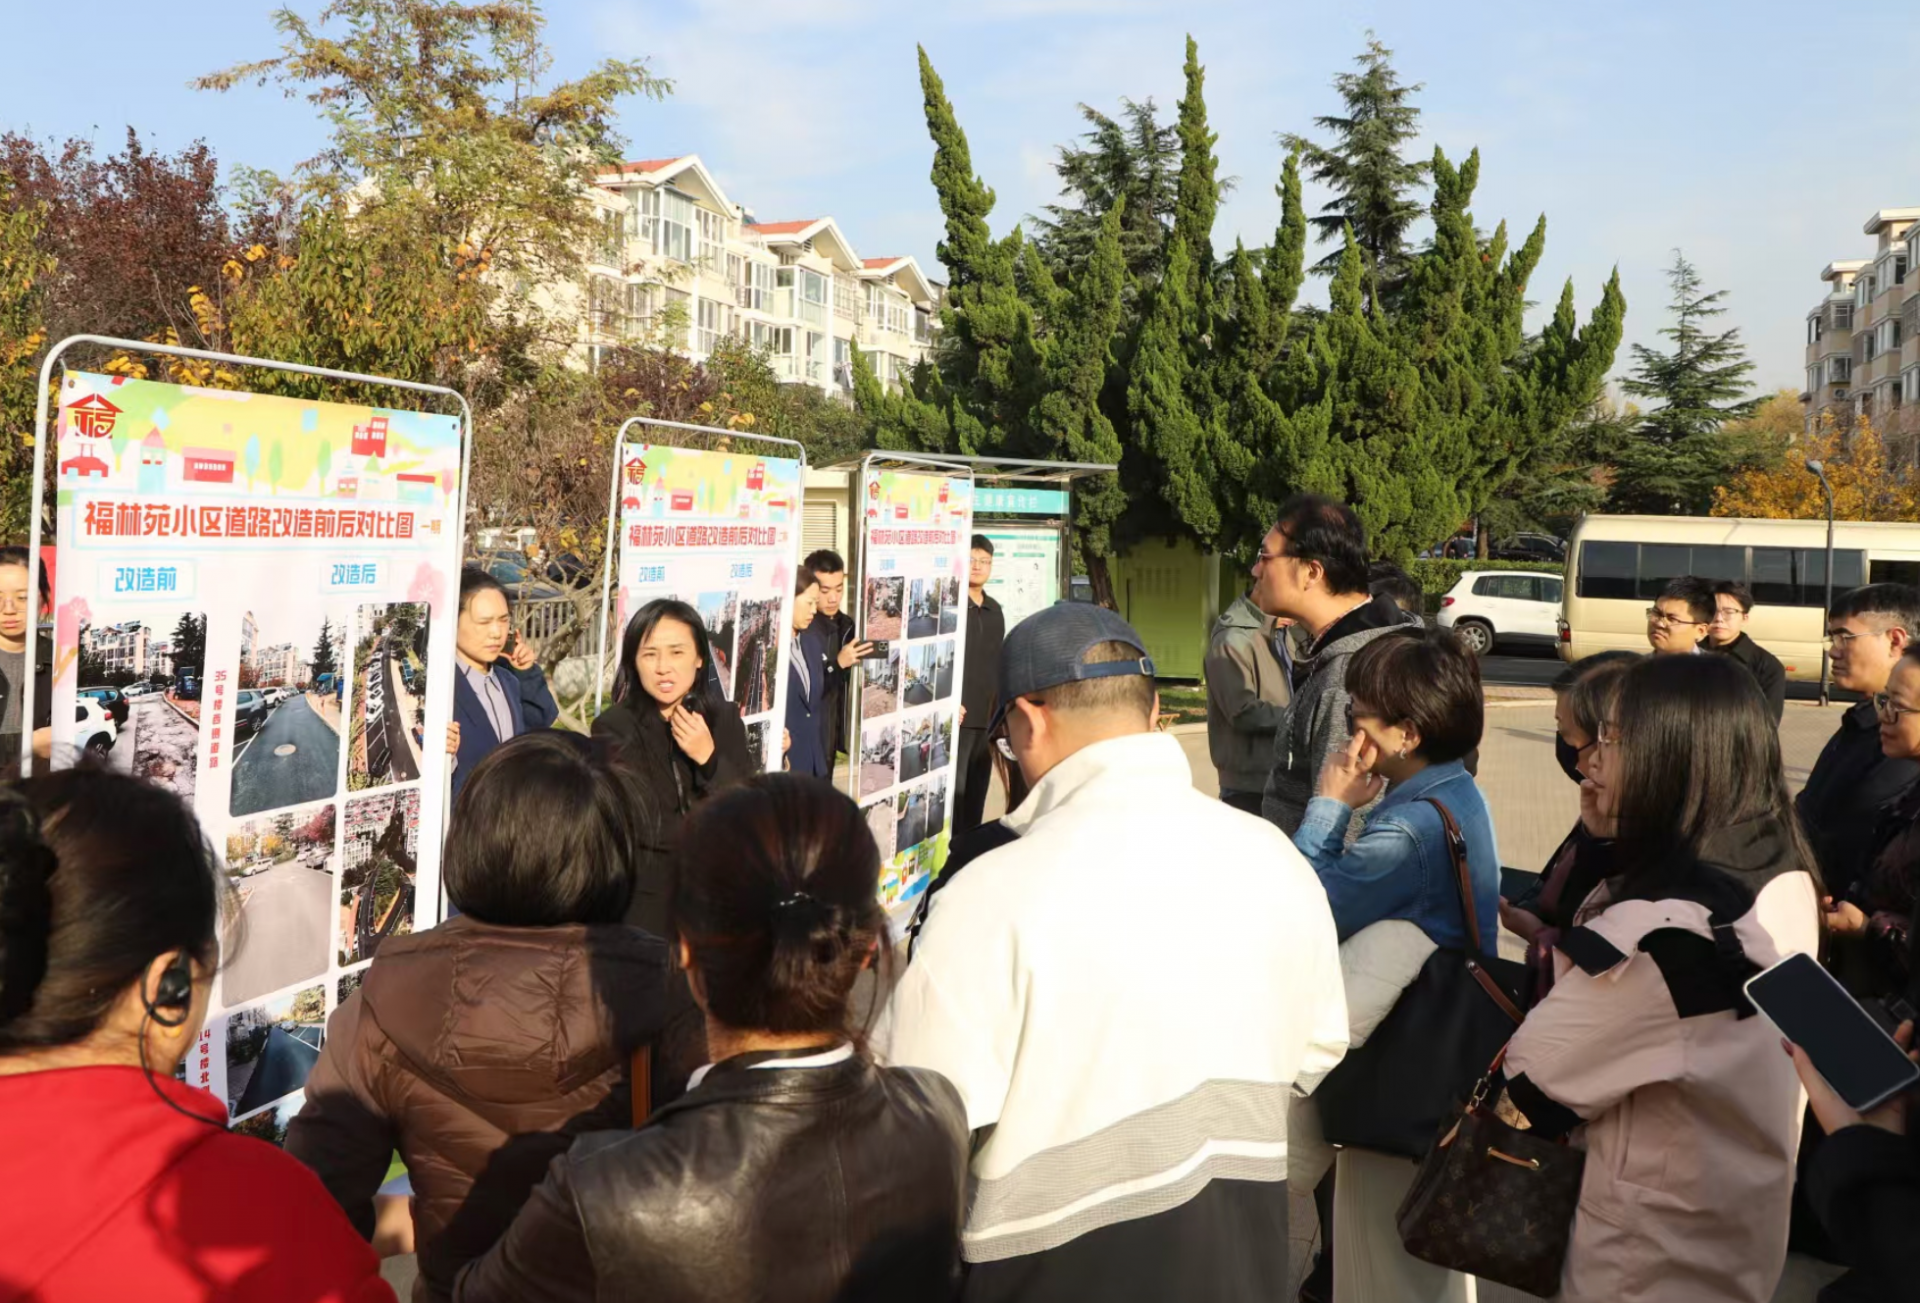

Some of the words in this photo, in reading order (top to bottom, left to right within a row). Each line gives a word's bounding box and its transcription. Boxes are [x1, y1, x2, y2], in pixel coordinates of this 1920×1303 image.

[84, 500, 415, 539] 福林苑小区道路改造前后对比图
[628, 525, 776, 547] 福林苑小区道路改造前后对比图
[114, 566, 177, 592] 改造前
[331, 563, 377, 585] 改造后
[638, 566, 666, 583] 改造前
[729, 563, 754, 579] 改造后
